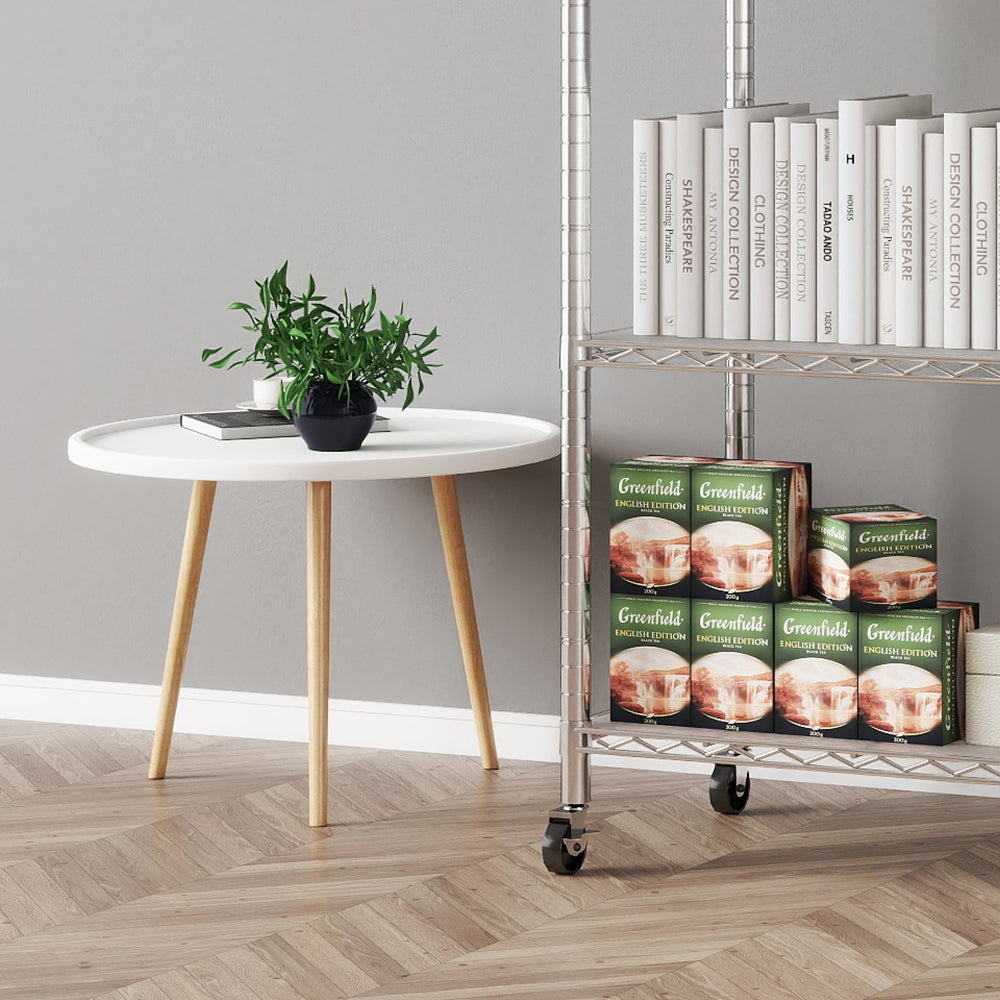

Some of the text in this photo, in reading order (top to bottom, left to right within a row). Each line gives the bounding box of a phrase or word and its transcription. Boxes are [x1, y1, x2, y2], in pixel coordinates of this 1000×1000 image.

[846, 154, 855, 164] H
[663, 172, 675, 226] Constructing
[882, 178, 893, 234] Constructing
[682, 179, 693, 273] SHAKESPEARE
[709, 191, 717, 274] MY ANTONIA
[729, 147, 740, 301] DESIGN COLLECTION
[754, 194, 766, 268] CLOTHING
[775, 160, 788, 300] DESIGN COLLECTION
[796, 164, 806, 303] DESIGN COLLECTION
[823, 201, 832, 262] TADAO ANDO
[901, 185, 913, 281] SHAKESPEARE
[949, 153, 961, 309] DESIGN COLLECTION
[928, 198, 937, 282] MY ANTONIA
[976, 201, 988, 276] CLOTHING
[618, 477, 683, 496] Greenfield
[700, 482, 765, 501] Greenfield
[615, 499, 687, 511] ENGLISH EDITION
[696, 504, 769, 515] ENGLISH EDITION
[859, 528, 929, 544] Greenfield
[895, 543, 933, 551] EDITION
[618, 606, 683, 626] Greenfield
[700, 612, 765, 632] Greenfield
[615, 629, 687, 640] ENGLISH EDITION
[783, 618, 849, 638] Greenfield
[867, 623, 934, 643] Greenfield
[696, 634, 769, 646] ENGLISH EDITION
[780, 640, 853, 652] ENGLISH EDITION
[863, 646, 938, 658] ENGLISH EDITION
